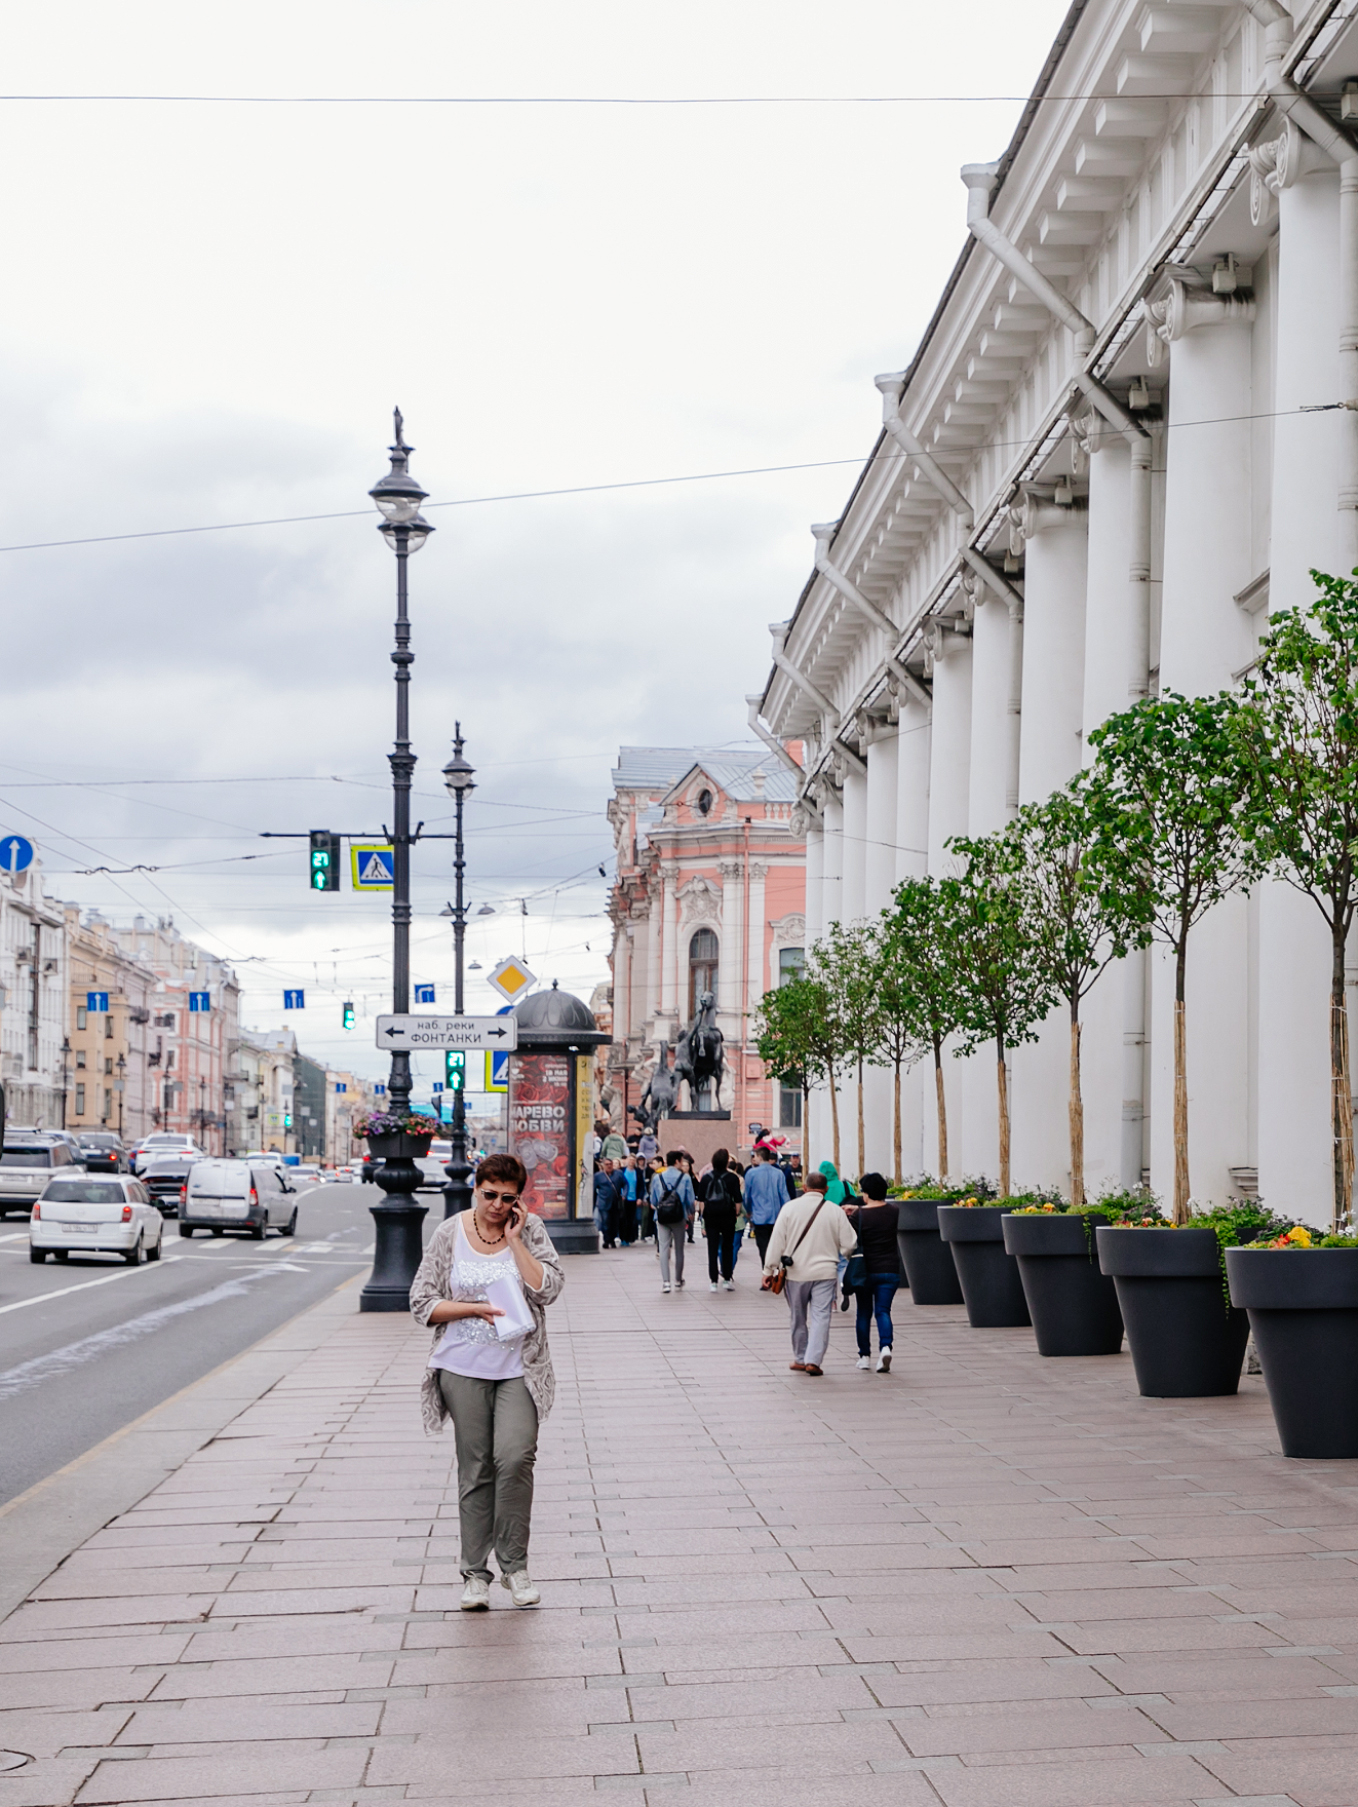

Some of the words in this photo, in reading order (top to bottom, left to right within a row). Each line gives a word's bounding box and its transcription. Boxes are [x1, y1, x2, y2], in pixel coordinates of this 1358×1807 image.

[417, 1020, 441, 1030] наб.
[446, 1021, 475, 1032] реки
[411, 1033, 482, 1043] ФОНТАНКИ
[449, 1052, 464, 1067] 27
